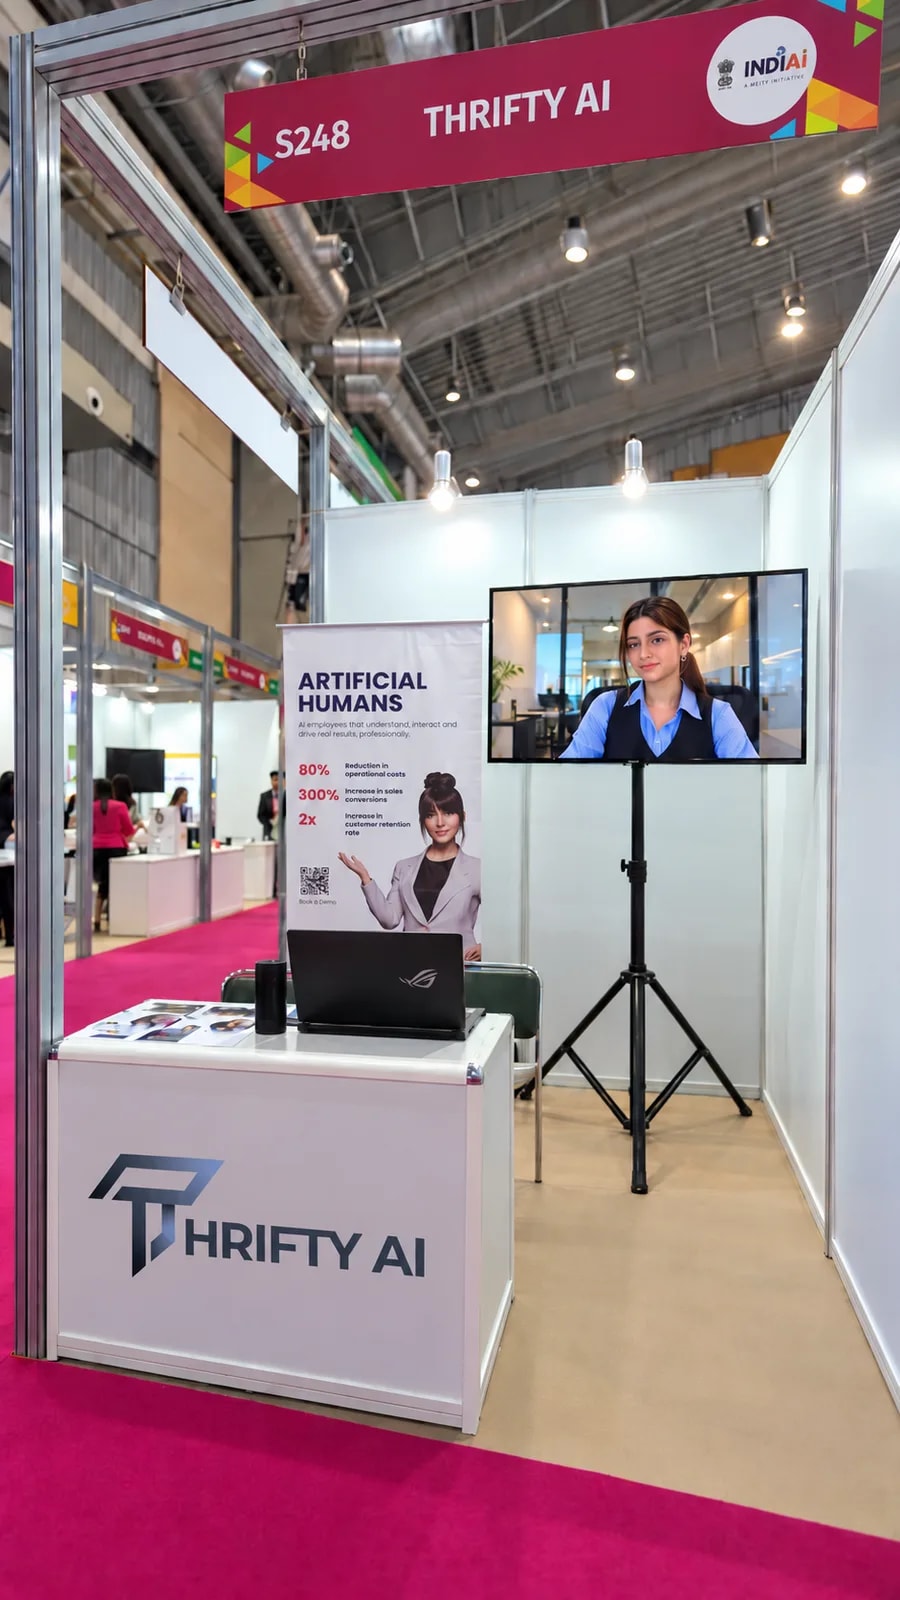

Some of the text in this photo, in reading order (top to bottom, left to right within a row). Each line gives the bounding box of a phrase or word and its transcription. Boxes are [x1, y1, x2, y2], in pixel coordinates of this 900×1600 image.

[423, 79, 611, 138] THRIFTY AI
[274, 119, 351, 159] S248
[298, 672, 428, 690] ARTIFICIAL
[298, 694, 403, 713] HUMANS
[306, 721, 348, 730] employees
[365, 721, 411, 729] understand,
[317, 730, 332, 738] real
[359, 730, 411, 740] professionally.
[299, 764, 330, 776] 80%
[298, 789, 340, 801] 300%
[298, 813, 317, 826] 2x
[371, 1235, 425, 1278] AI
